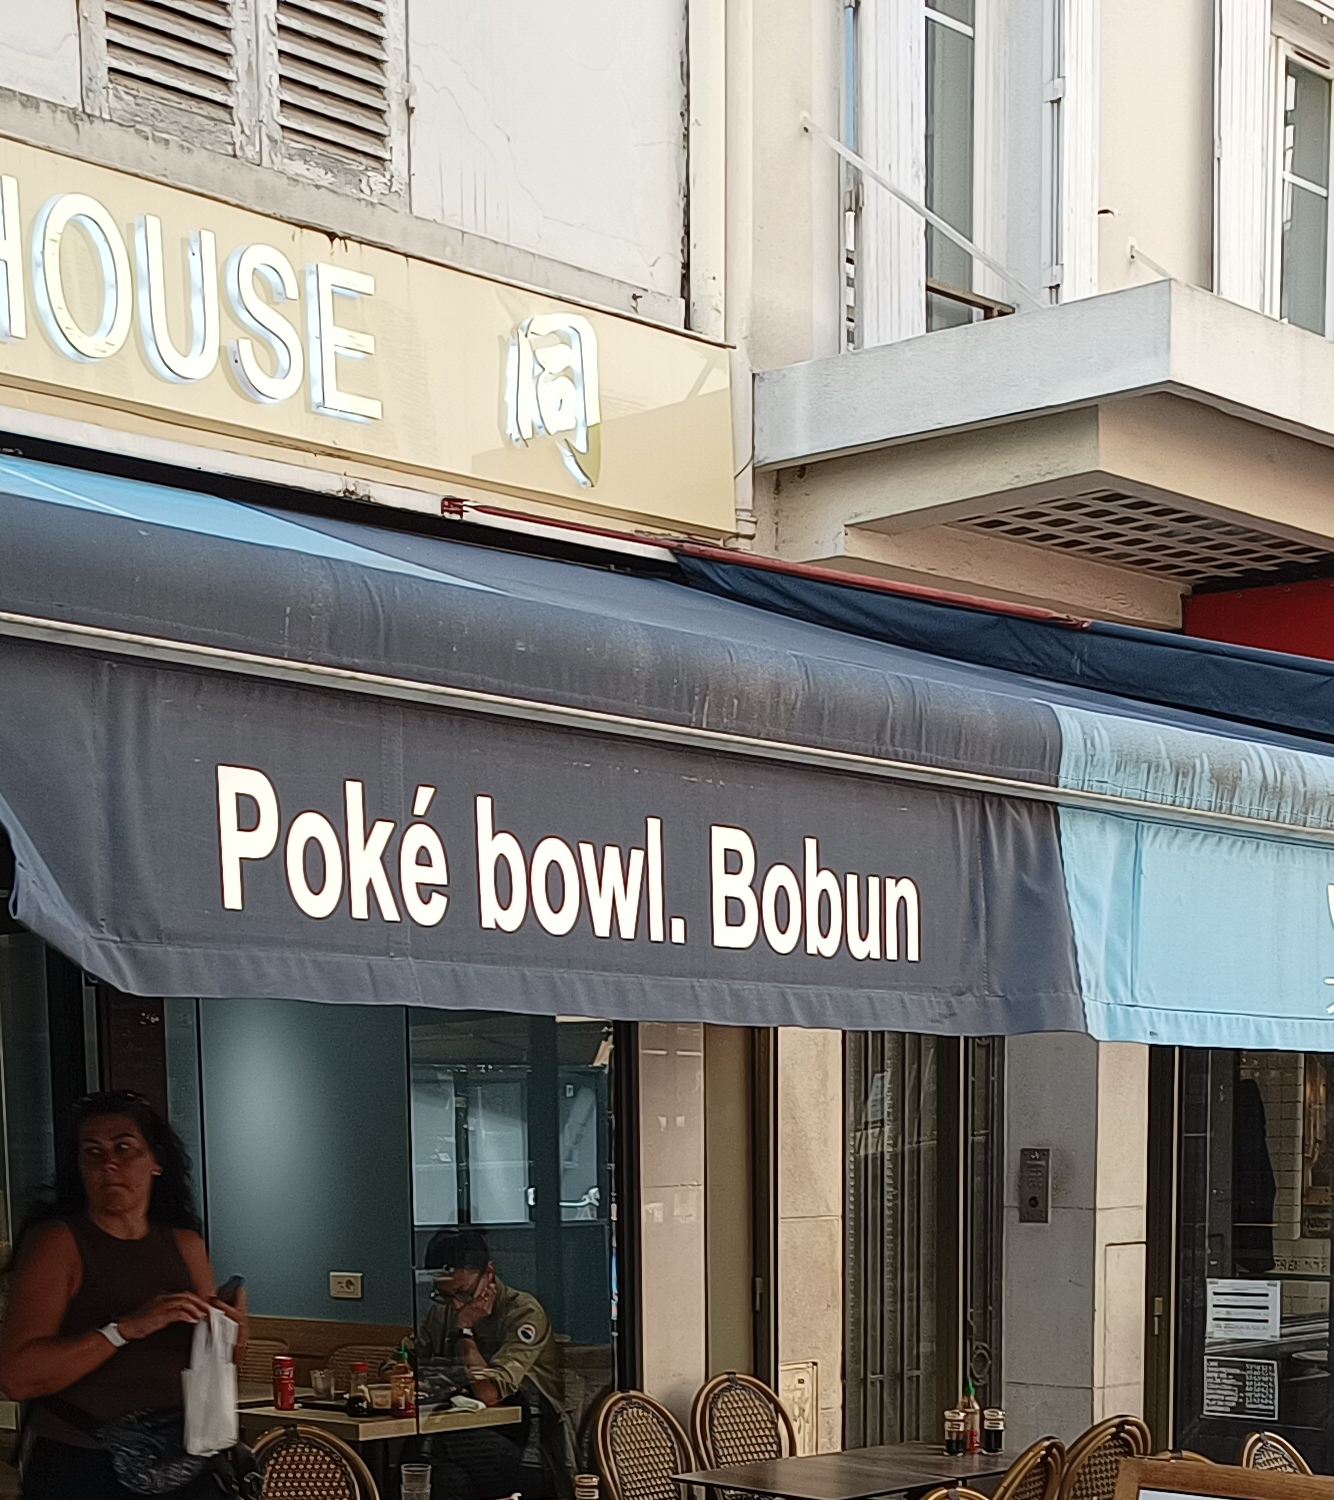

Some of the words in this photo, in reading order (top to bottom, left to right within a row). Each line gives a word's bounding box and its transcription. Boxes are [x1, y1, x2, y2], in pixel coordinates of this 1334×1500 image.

[215, 763, 450, 928] Poké
[475, 794, 687, 945] bowl.
[709, 824, 922, 963] Bobun
